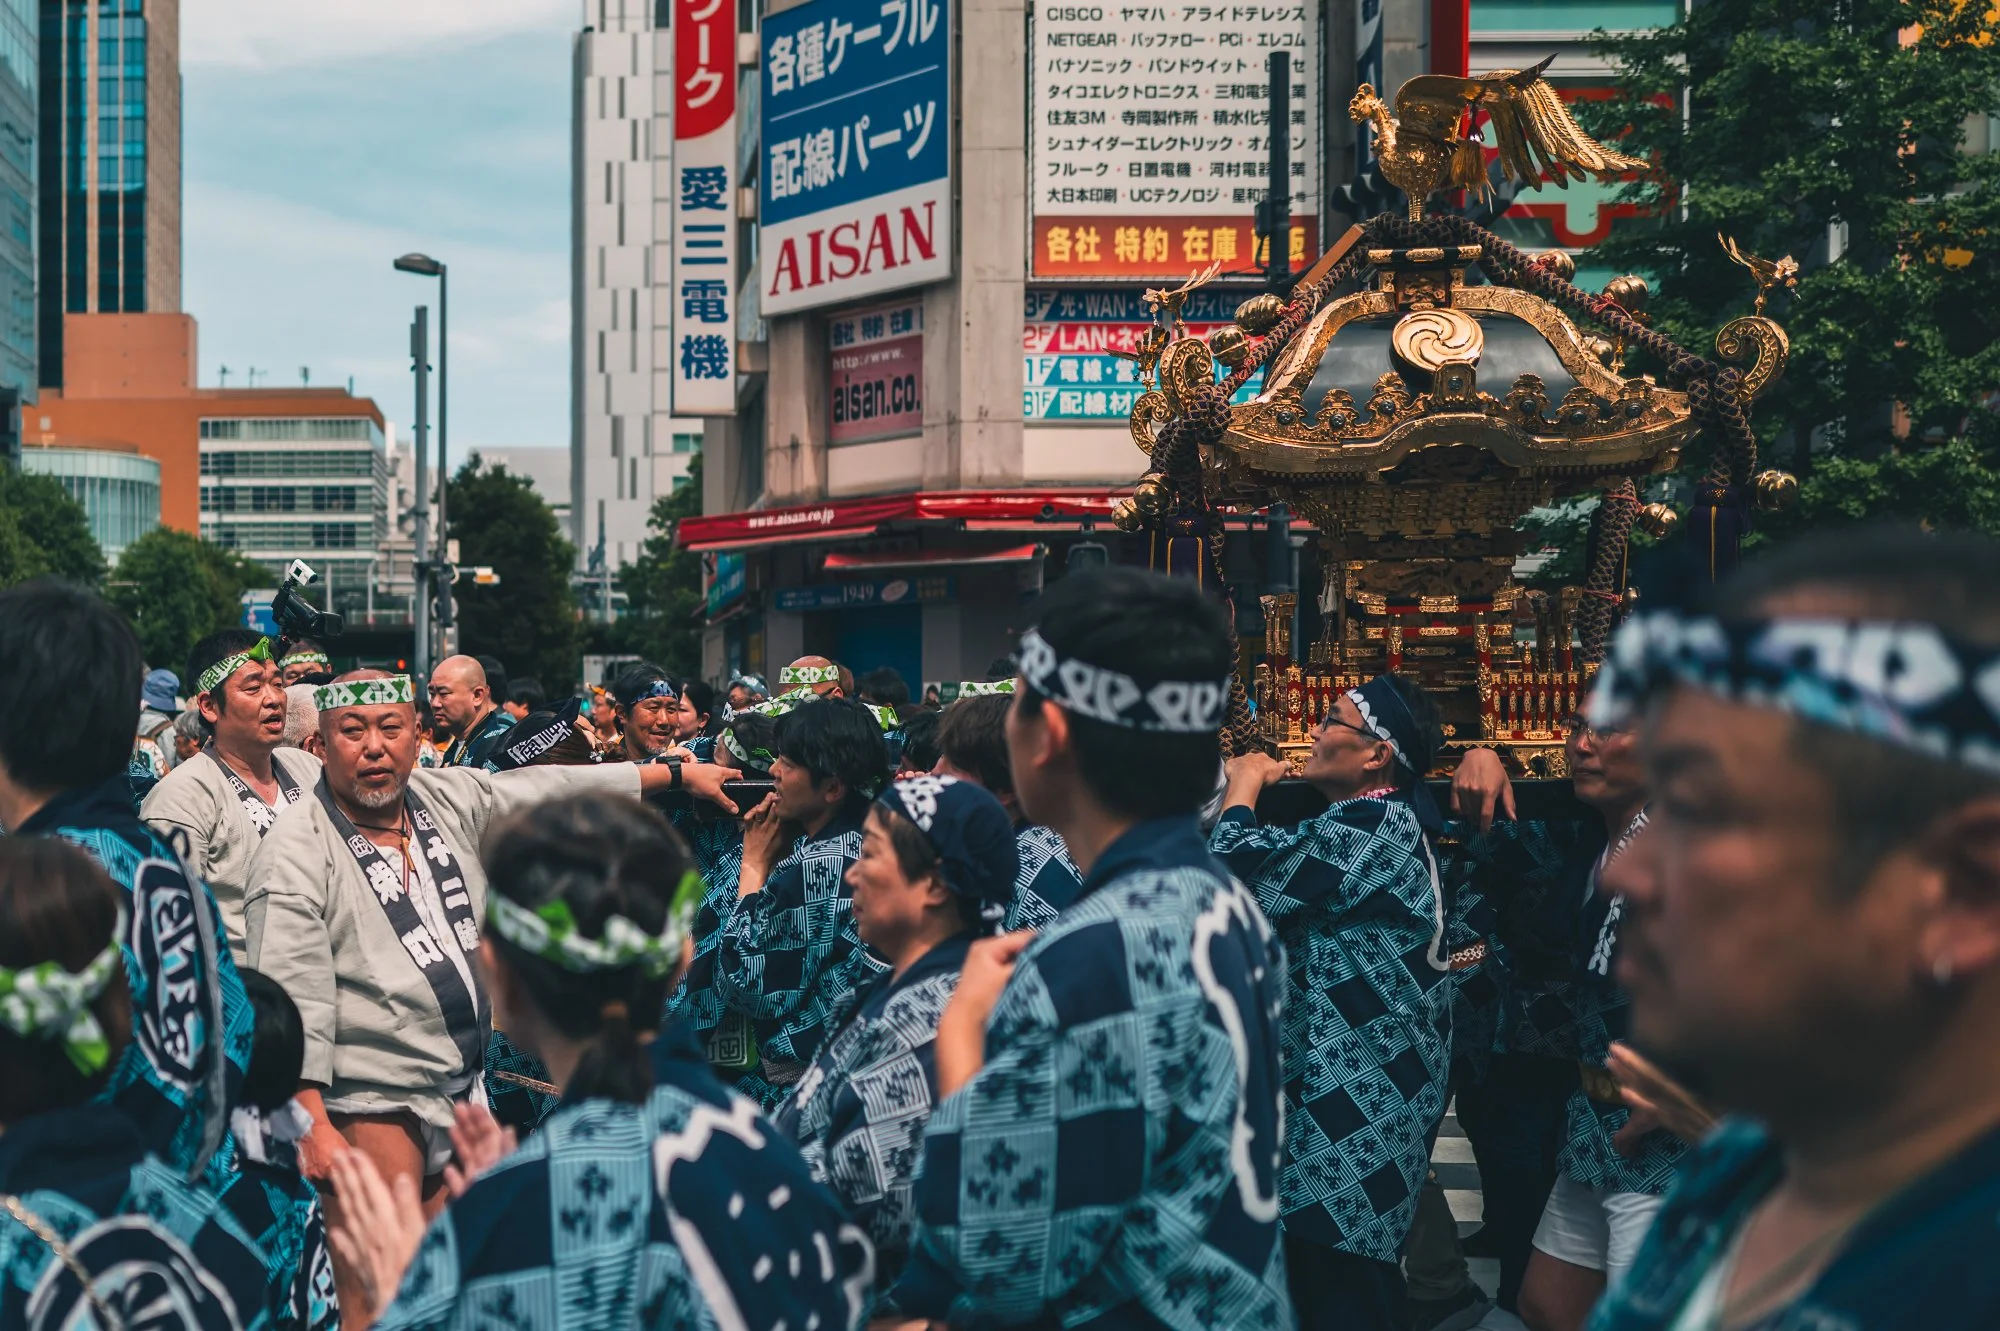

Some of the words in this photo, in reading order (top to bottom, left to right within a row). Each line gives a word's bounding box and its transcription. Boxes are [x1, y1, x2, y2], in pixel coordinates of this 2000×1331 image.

[1047, 7, 1103, 21] CISCO
[1120, 7, 1165, 21] ヤマハ
[1047, 33, 1117, 47] NETGEAR
[1257, 33, 1306, 47] エレコム
[1215, 84, 1306, 99] 三和電気業
[1047, 110, 1106, 125] 住友3M
[1213, 110, 1306, 126] 積水化学業
[770, 101, 936, 200] 配線パーツ
[1047, 162, 1109, 177] フルーク
[1129, 162, 1192, 177] 日置電機
[1210, 162, 1306, 177] 河村電器業
[1047, 188, 1117, 204] 大日本印刷
[769, 200, 936, 296] AISAN
[1047, 227, 1101, 263] 各社
[1114, 227, 1169, 263] 特約
[1182, 226, 1237, 263] 在庫
[681, 165, 728, 380] 愛三電機
